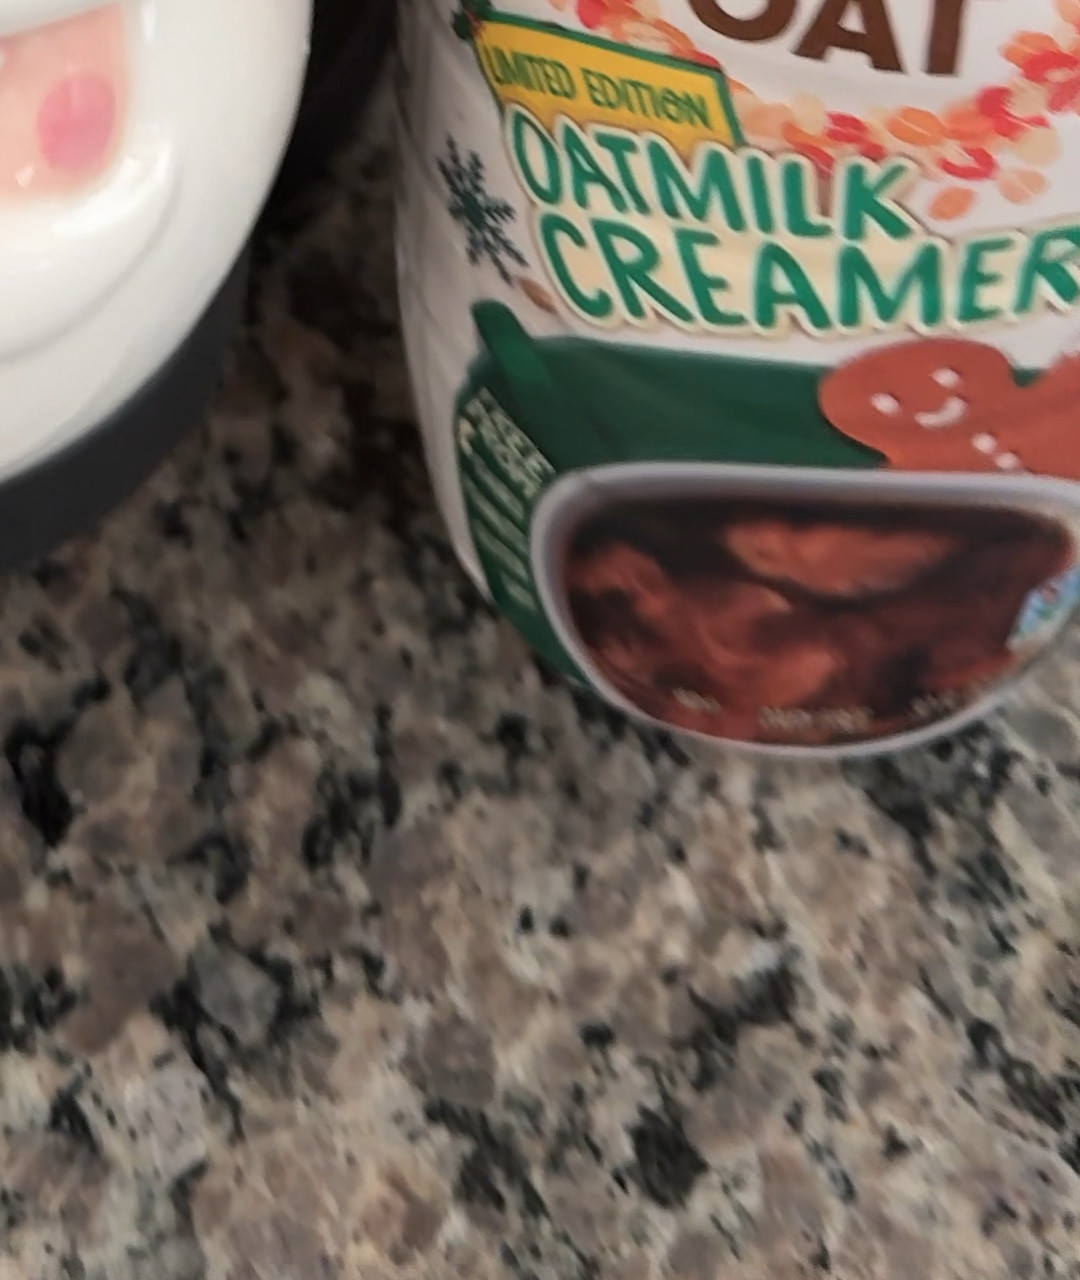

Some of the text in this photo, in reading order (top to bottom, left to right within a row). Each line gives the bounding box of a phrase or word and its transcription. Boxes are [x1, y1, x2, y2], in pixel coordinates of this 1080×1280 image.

[579, 66, 714, 131] EDITION
[510, 108, 916, 242] OATMILK
[538, 212, 1080, 332] CREAMER
